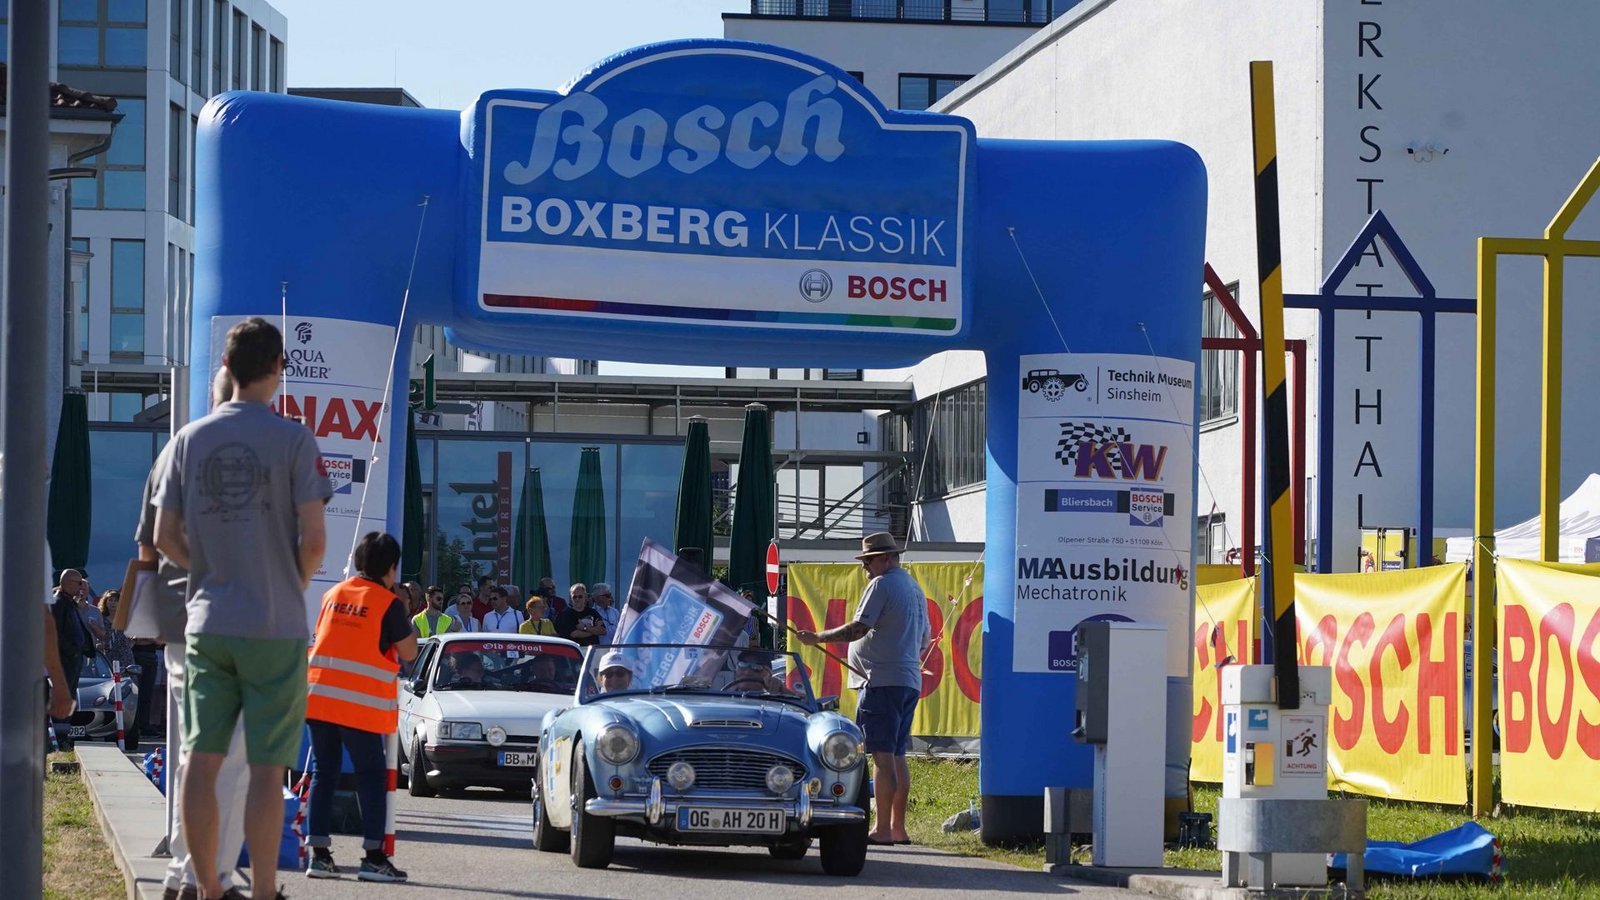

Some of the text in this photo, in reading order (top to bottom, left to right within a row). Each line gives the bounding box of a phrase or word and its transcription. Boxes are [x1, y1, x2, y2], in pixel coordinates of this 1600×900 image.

[503, 73, 846, 186] Bosch
[501, 195, 947, 257] BOXBERG KLASSIK
[848, 275, 947, 302] BOSCH
[281, 362, 329, 379] ÖMER
[1107, 369, 1192, 390] Technik Museum
[1107, 388, 1162, 402] Sinsheim
[272, 395, 384, 443] NAX
[1074, 441, 1168, 481] KW
[324, 470, 351, 479] rvice
[1061, 497, 1113, 507] Bliersbach
[1131, 493, 1163, 504] BOSCH
[1131, 503, 1163, 513] Service
[500, 486, 510, 588] RAUEREI
[1057, 536, 1085, 544] Olpener
[1087, 536, 1109, 544] Straße
[1017, 585, 1128, 602] Mechatronik
[694, 612, 711, 640] BOSCH
[482, 642, 543, 652] Old School
[1053, 659, 1077, 667] BOSC
[505, 753, 520, 765] BB
[690, 810, 710, 827] OG
[722, 811, 742, 828] AH
[747, 812, 765, 829] 20
[769, 813, 779, 829] H
